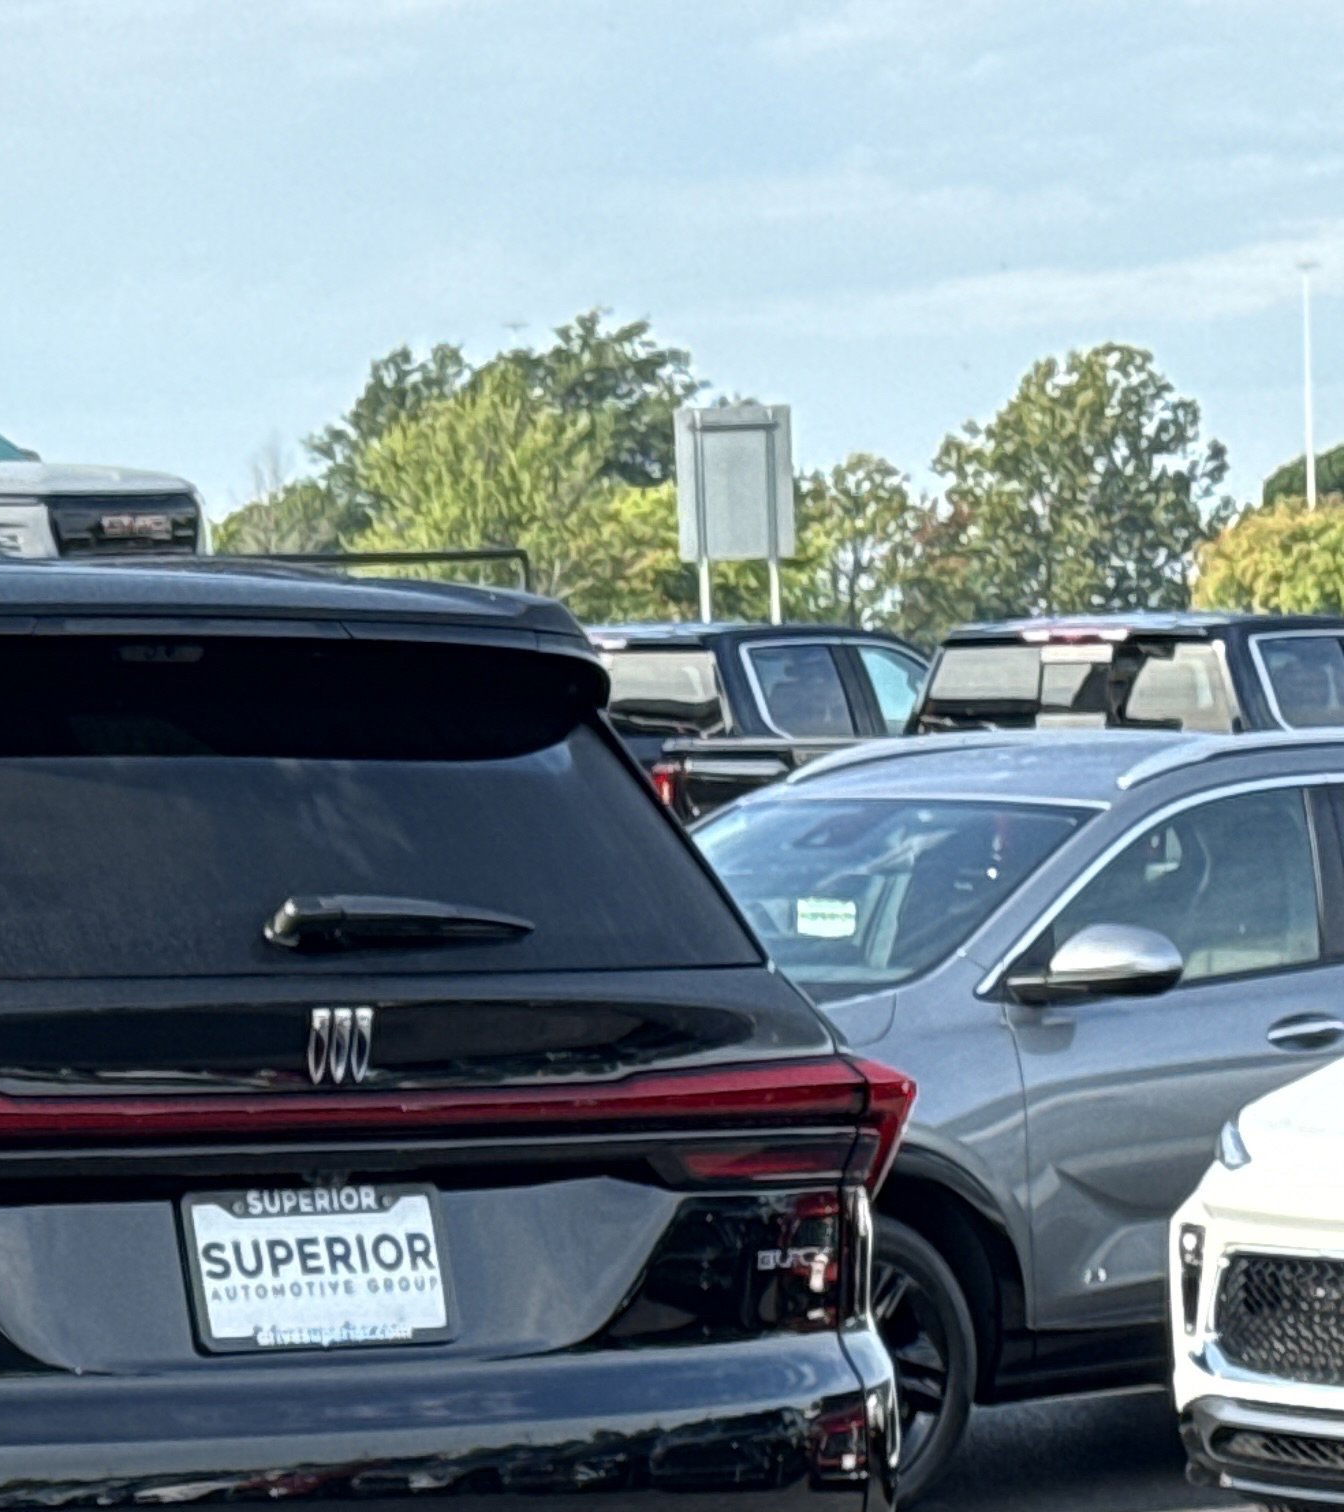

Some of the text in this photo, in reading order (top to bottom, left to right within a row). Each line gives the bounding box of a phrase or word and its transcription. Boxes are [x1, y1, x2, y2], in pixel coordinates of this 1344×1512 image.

[245, 1185, 380, 1215] SUPERIOR
[201, 1231, 437, 1281] SUPERIOR
[210, 1275, 439, 1302] AUTOMOTIVE GROUP
